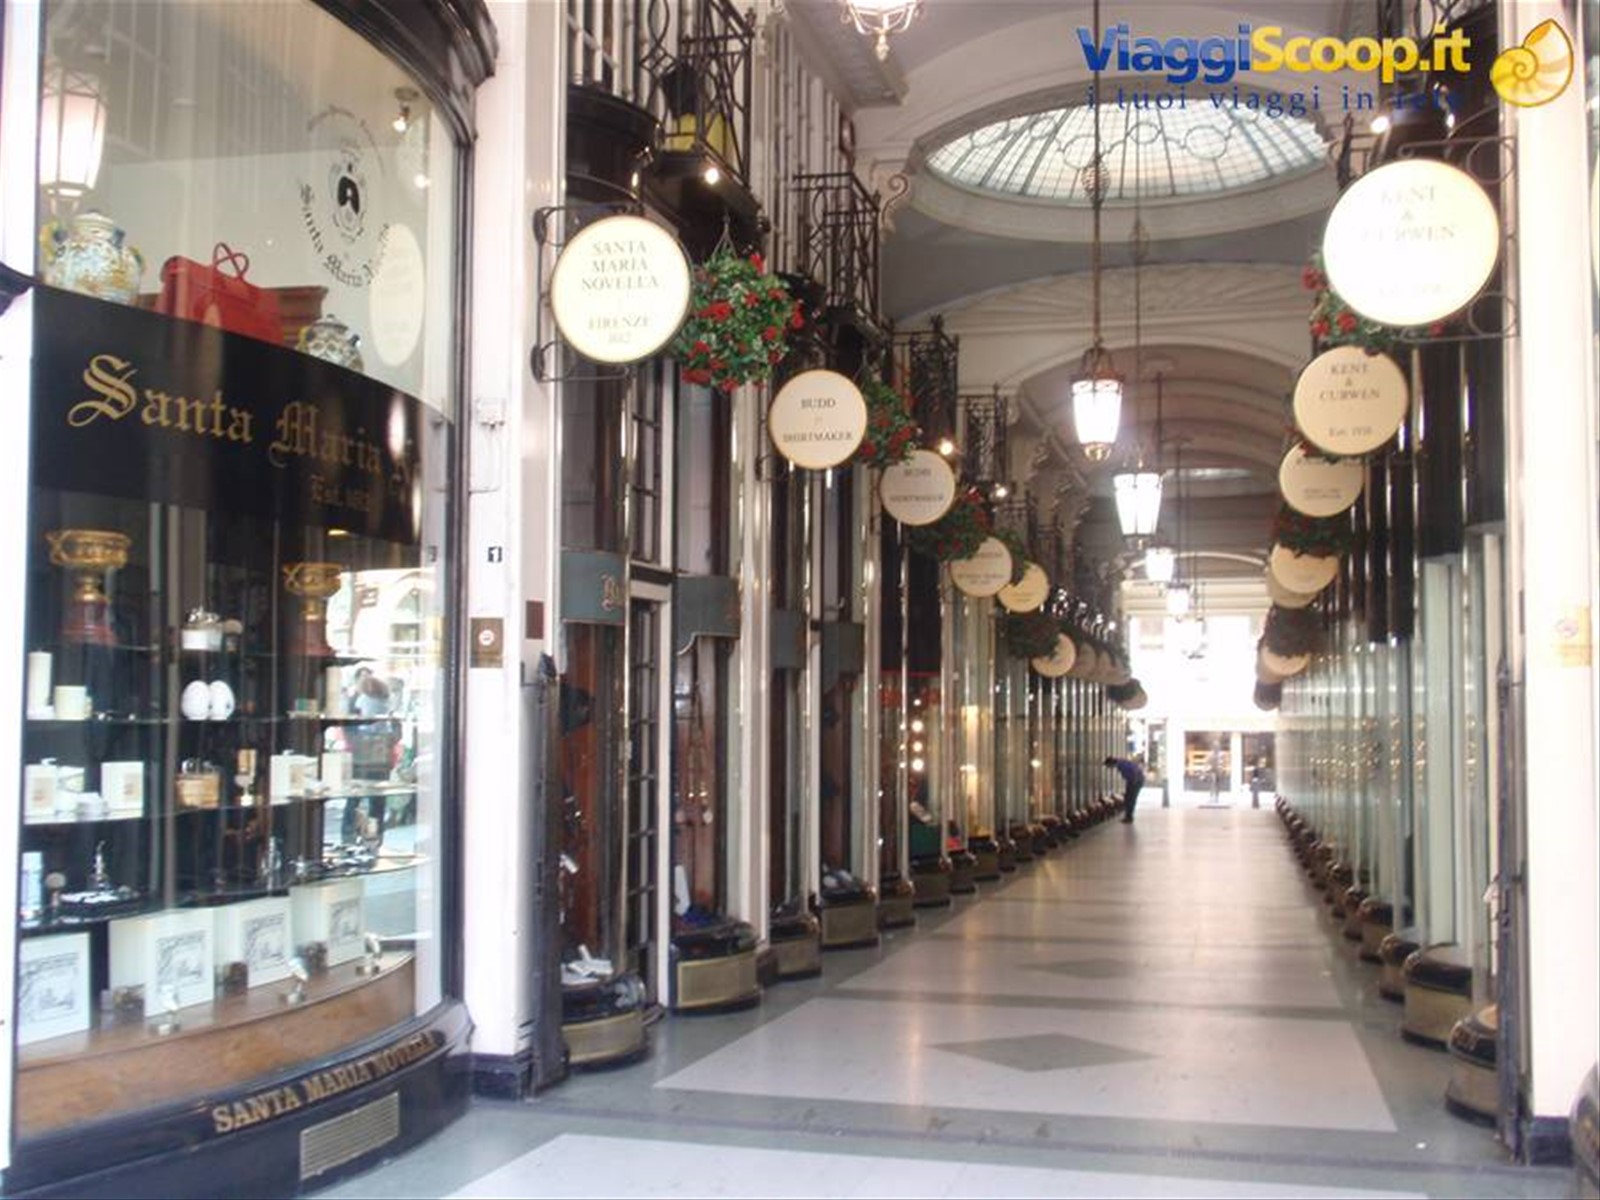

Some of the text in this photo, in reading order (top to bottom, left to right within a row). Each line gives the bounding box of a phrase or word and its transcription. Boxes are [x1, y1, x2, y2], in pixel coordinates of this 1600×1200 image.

[592, 240, 648, 256] SANTA
[592, 257, 649, 273] MARIA
[581, 275, 660, 291] NOVELLA
[588, 316, 650, 331] FIRENZE
[1331, 363, 1370, 375] KENT
[1319, 388, 1381, 401] CURWEN
[800, 397, 837, 409] BUDD
[67, 354, 382, 469] Santa Maria
[783, 431, 852, 443] SHIRTMAKER
[212, 1086, 300, 1133] SANTA
[302, 1061, 371, 1101] MARIA
